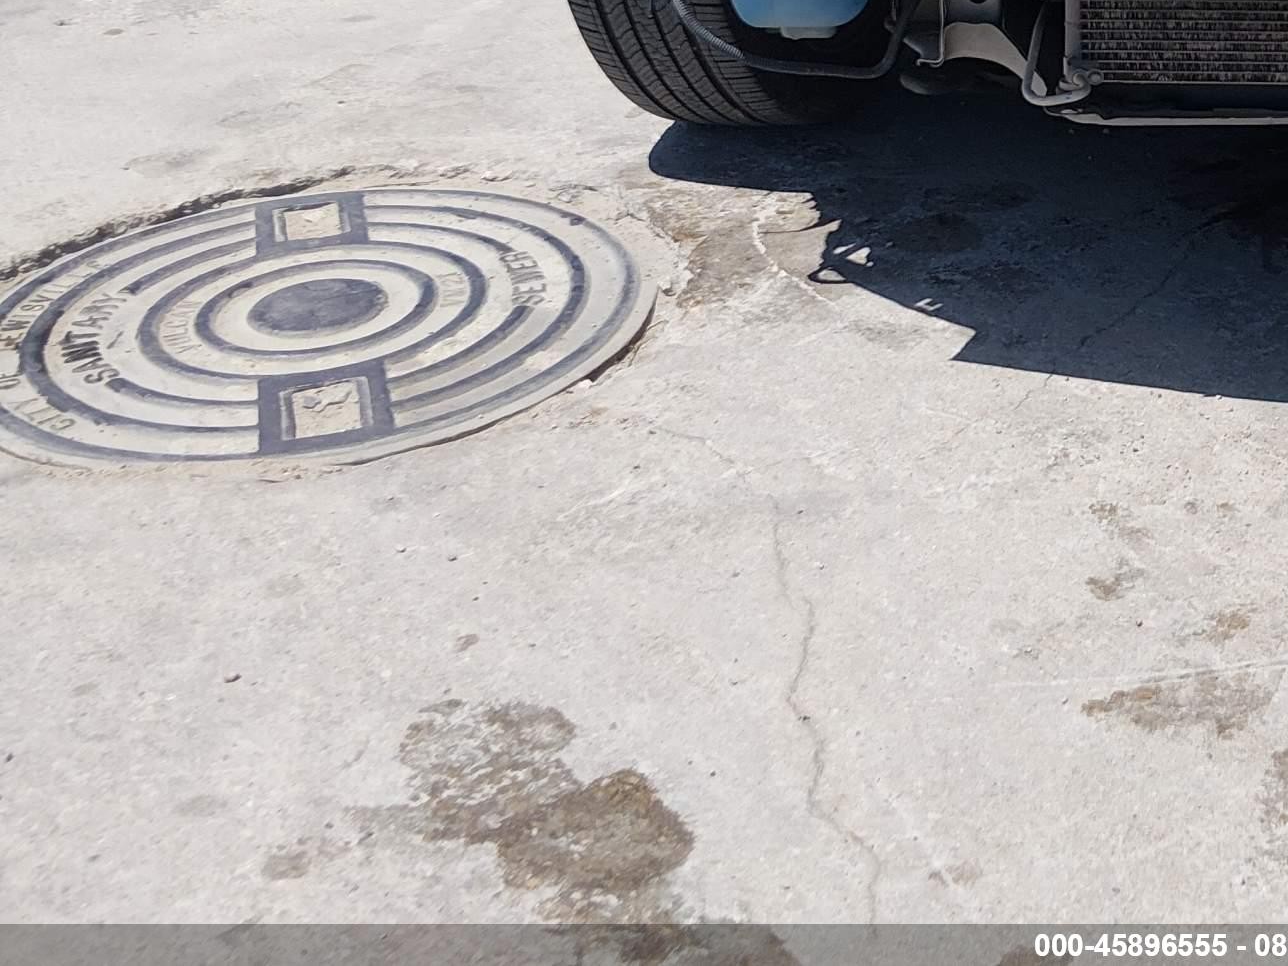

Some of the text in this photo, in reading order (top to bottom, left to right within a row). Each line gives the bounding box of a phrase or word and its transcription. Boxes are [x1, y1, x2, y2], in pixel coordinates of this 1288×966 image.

[498, 250, 547, 306] SEWER
[58, 292, 128, 385] SANITARY
[162, 298, 203, 354] VULCAN
[8, 397, 77, 432] CITY
